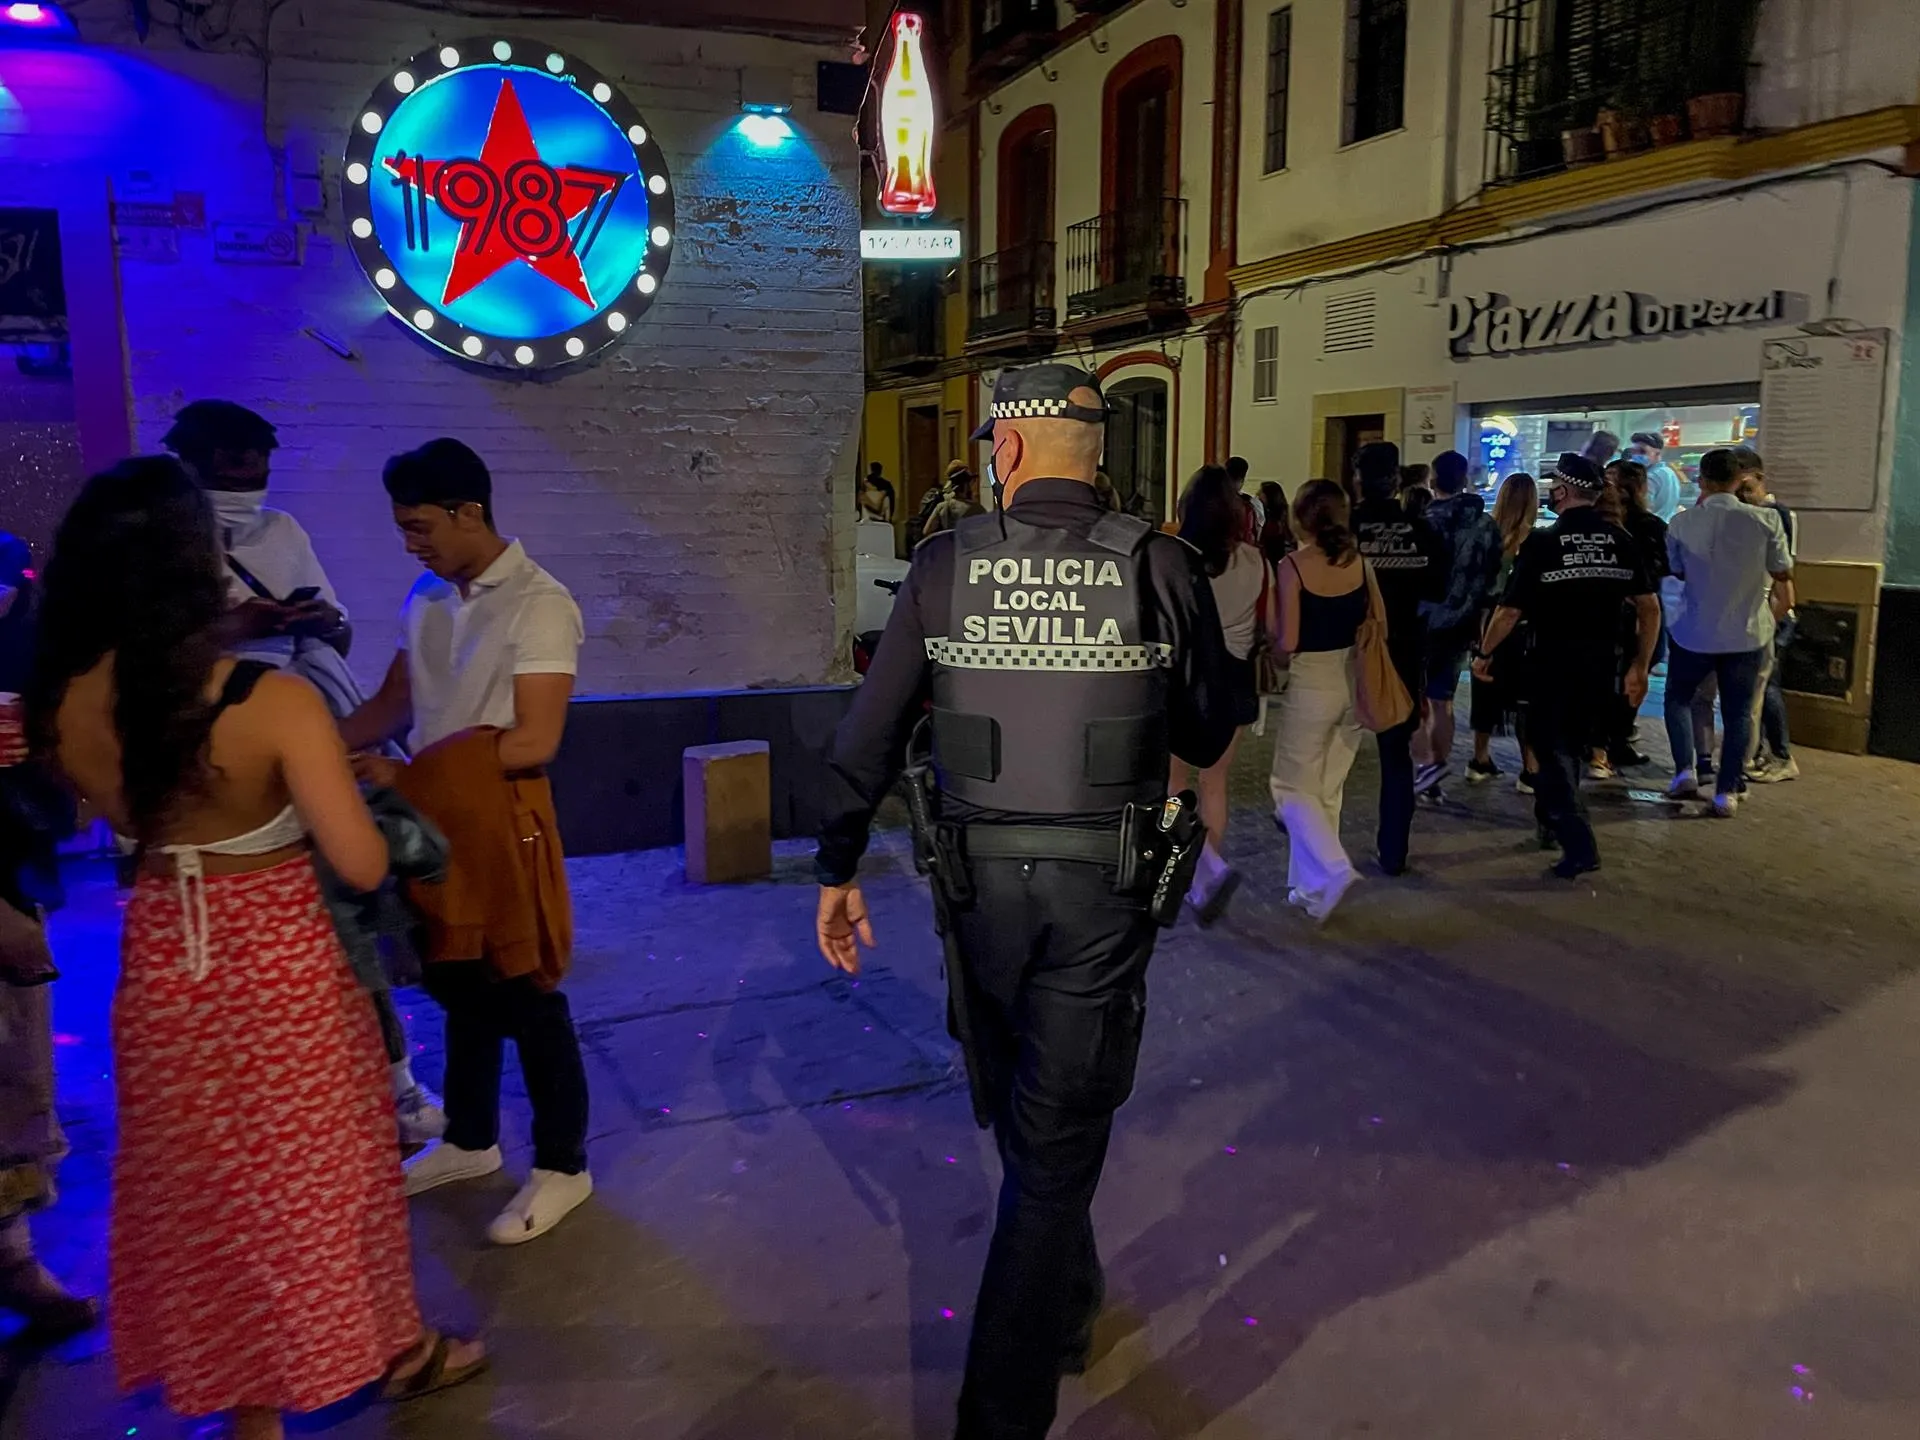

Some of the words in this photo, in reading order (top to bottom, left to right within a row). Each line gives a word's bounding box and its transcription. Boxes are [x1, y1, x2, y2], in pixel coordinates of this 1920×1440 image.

[391, 149, 629, 260] 1987
[868, 236, 910, 249] 197
[1562, 552, 1618, 566] SEVILLA
[968, 558, 1123, 587] POLICIA
[993, 590, 1086, 612] LOCAL
[963, 615, 1124, 645] SEVILLA
